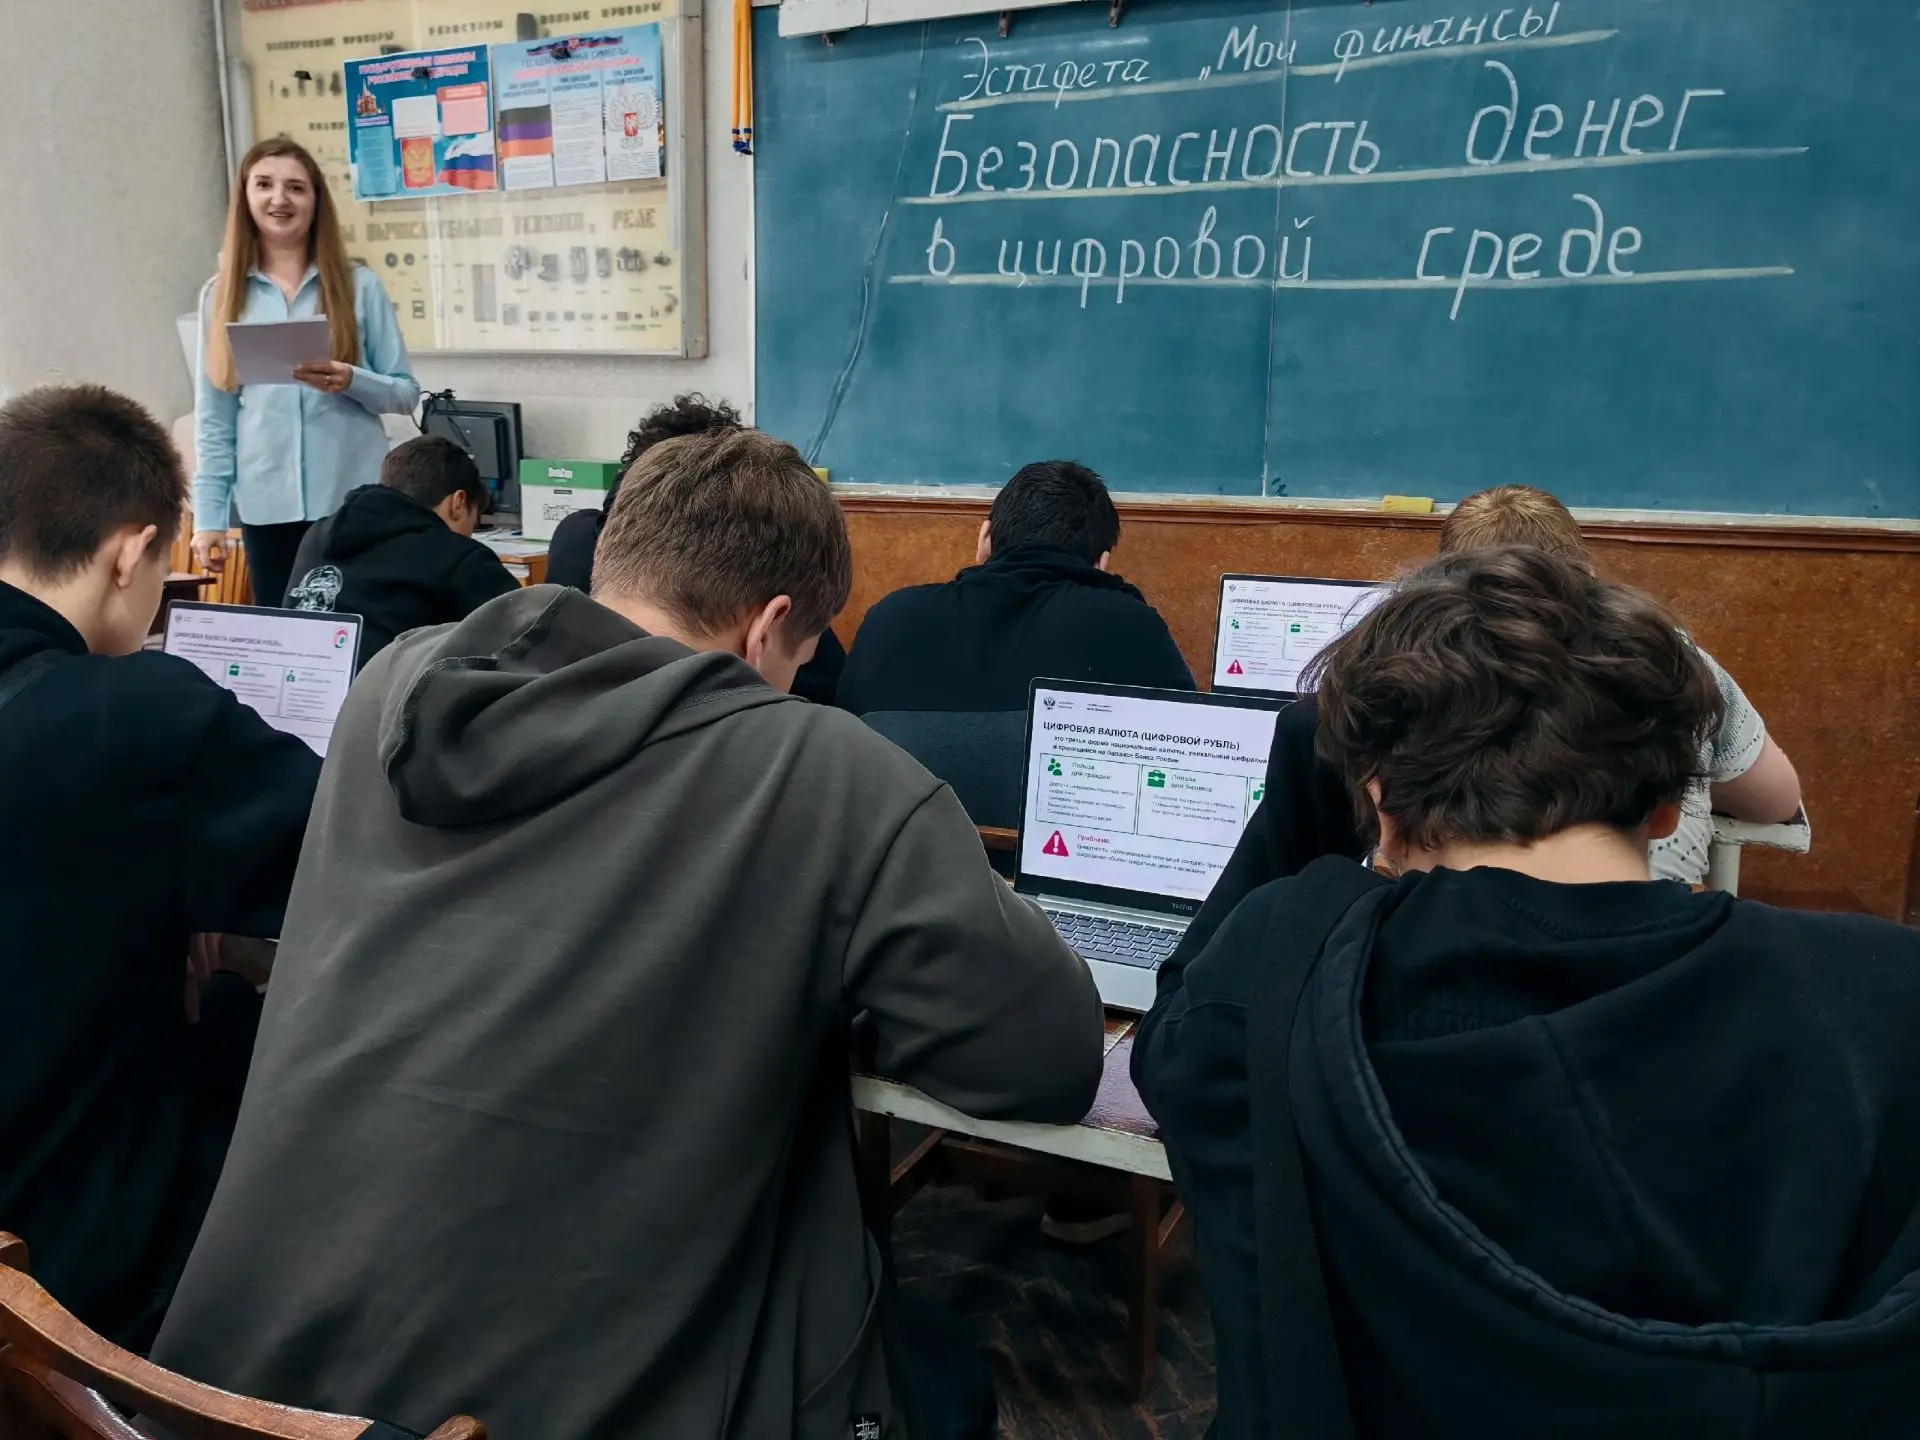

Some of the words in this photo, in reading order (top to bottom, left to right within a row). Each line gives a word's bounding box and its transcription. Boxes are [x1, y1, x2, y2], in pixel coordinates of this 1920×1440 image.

[957, 36, 1149, 109] Эстафета
[1334, 1, 1560, 84] финансы
[930, 113, 1381, 199] Безопасность
[1465, 60, 1726, 167] денег
[612, 208, 657, 231] РЕЛЕ
[926, 216, 956, 278] в
[997, 204, 1315, 309] цифровой
[1415, 193, 1642, 321] среде
[1043, 721, 1096, 735] ЦИФРОВАЯ
[1098, 727, 1139, 739] ВАЛЮТА
[1141, 732, 1201, 746] (ЦИФРОВОЙ
[1203, 738, 1240, 751] РУБЛЬ)
